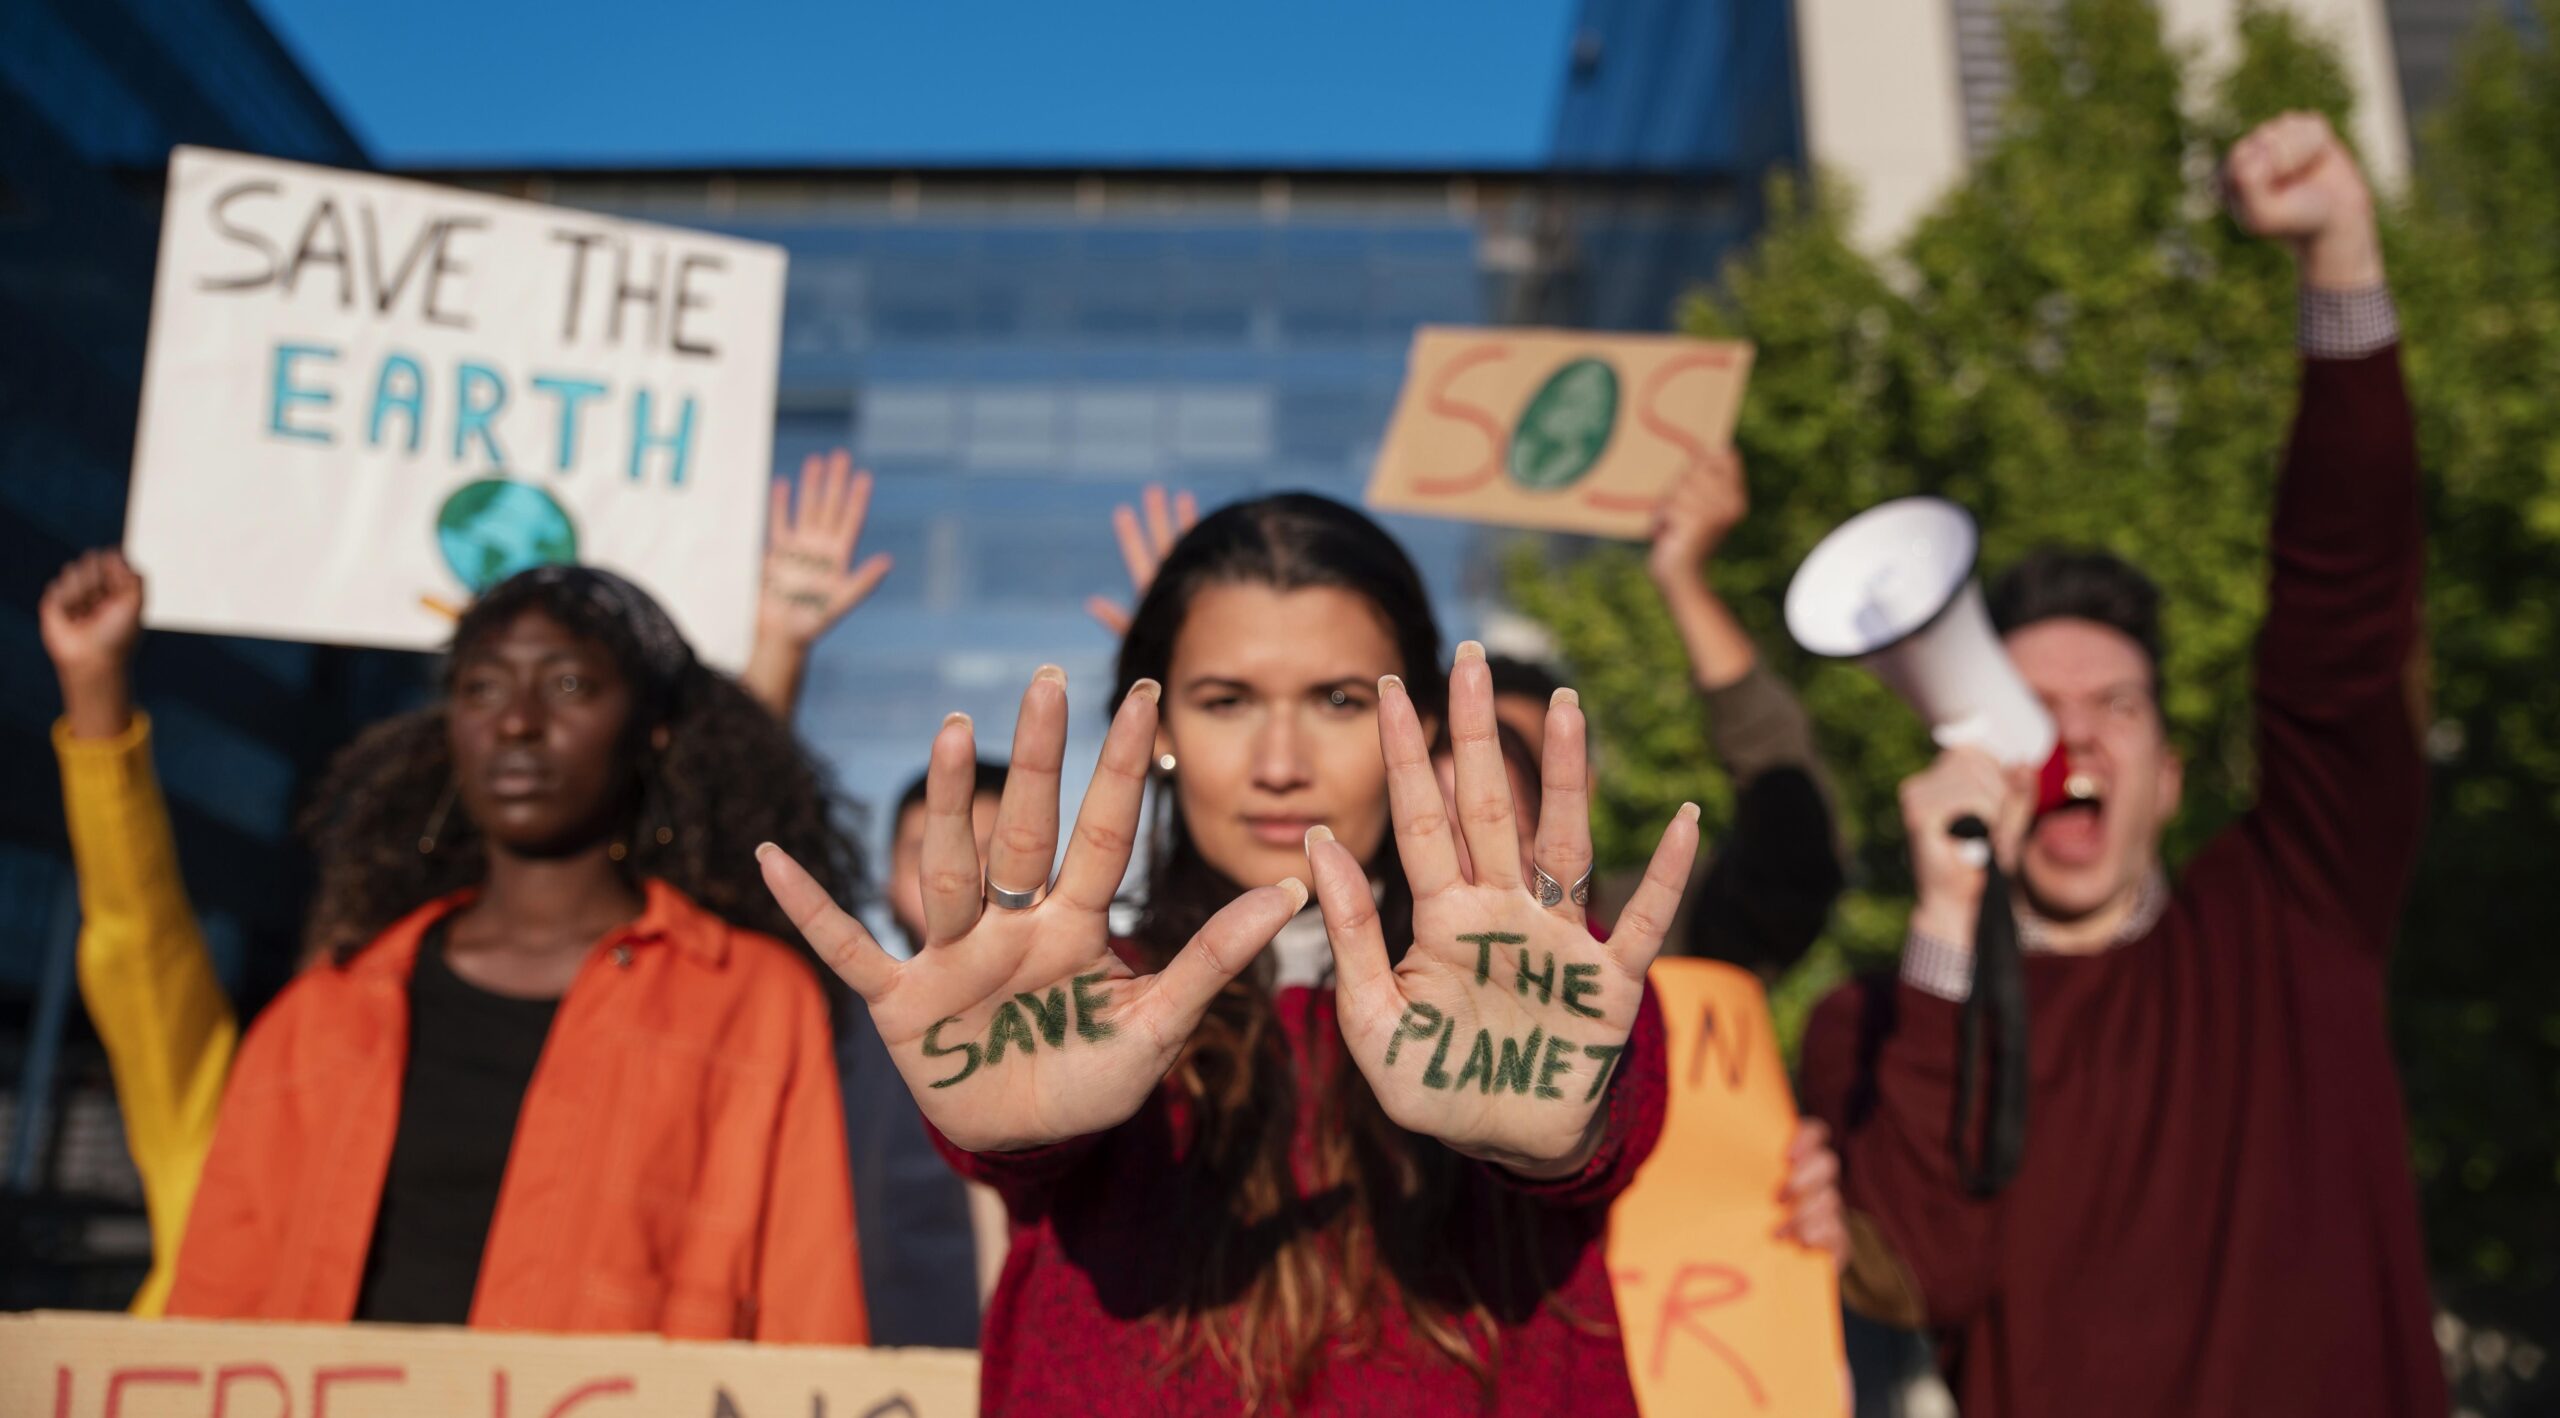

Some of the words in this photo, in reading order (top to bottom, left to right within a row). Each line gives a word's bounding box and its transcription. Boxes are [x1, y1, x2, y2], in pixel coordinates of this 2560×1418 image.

[195, 178, 494, 330] SAVE
[551, 226, 729, 359] THE
[266, 341, 698, 487] EARTH
[1411, 341, 1735, 520] SOS
[921, 965, 1120, 1089] SAVE
[1455, 931, 1606, 1019] THE
[1383, 1000, 1626, 1104] PLANET
